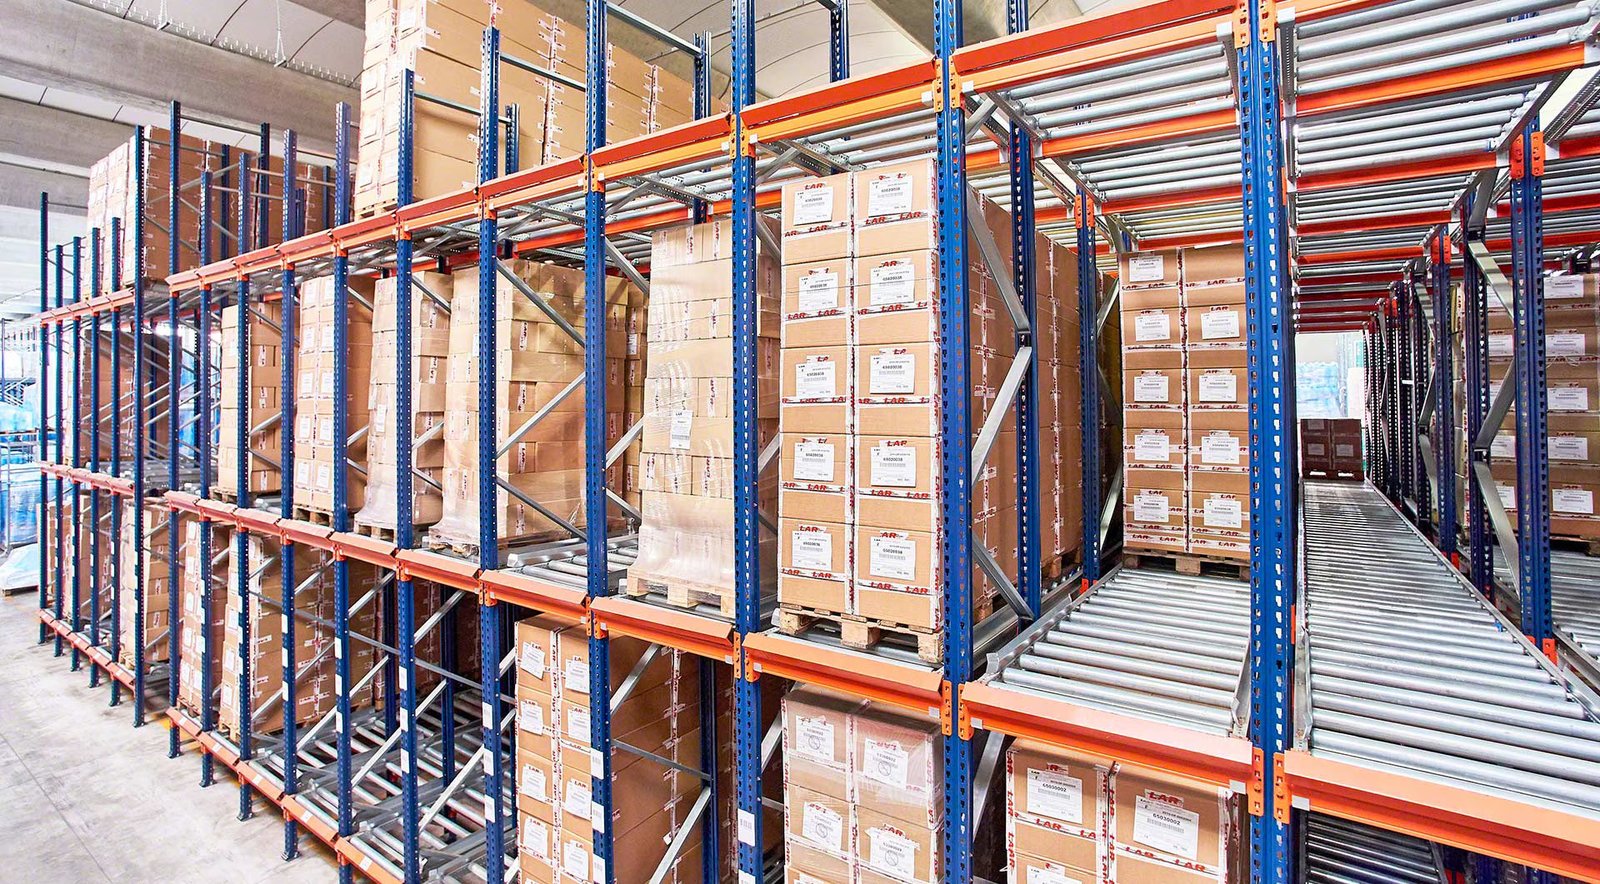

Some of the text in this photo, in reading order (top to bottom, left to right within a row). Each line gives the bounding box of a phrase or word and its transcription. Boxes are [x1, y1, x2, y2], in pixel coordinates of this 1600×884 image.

[865, 216, 886, 225] LAR
[900, 212, 921, 220] LAR
[809, 225, 828, 233] LAR
[870, 582, 892, 590] LAR
[906, 586, 929, 594] LAR
[1043, 783, 1066, 792] 65030002
[1149, 792, 1179, 804] LAR
[1153, 813, 1180, 825] 65030002
[1036, 819, 1062, 830] LAR
[1080, 830, 1096, 838] LA
[1126, 846, 1154, 858] LAR
[1175, 859, 1205, 872] LAR
